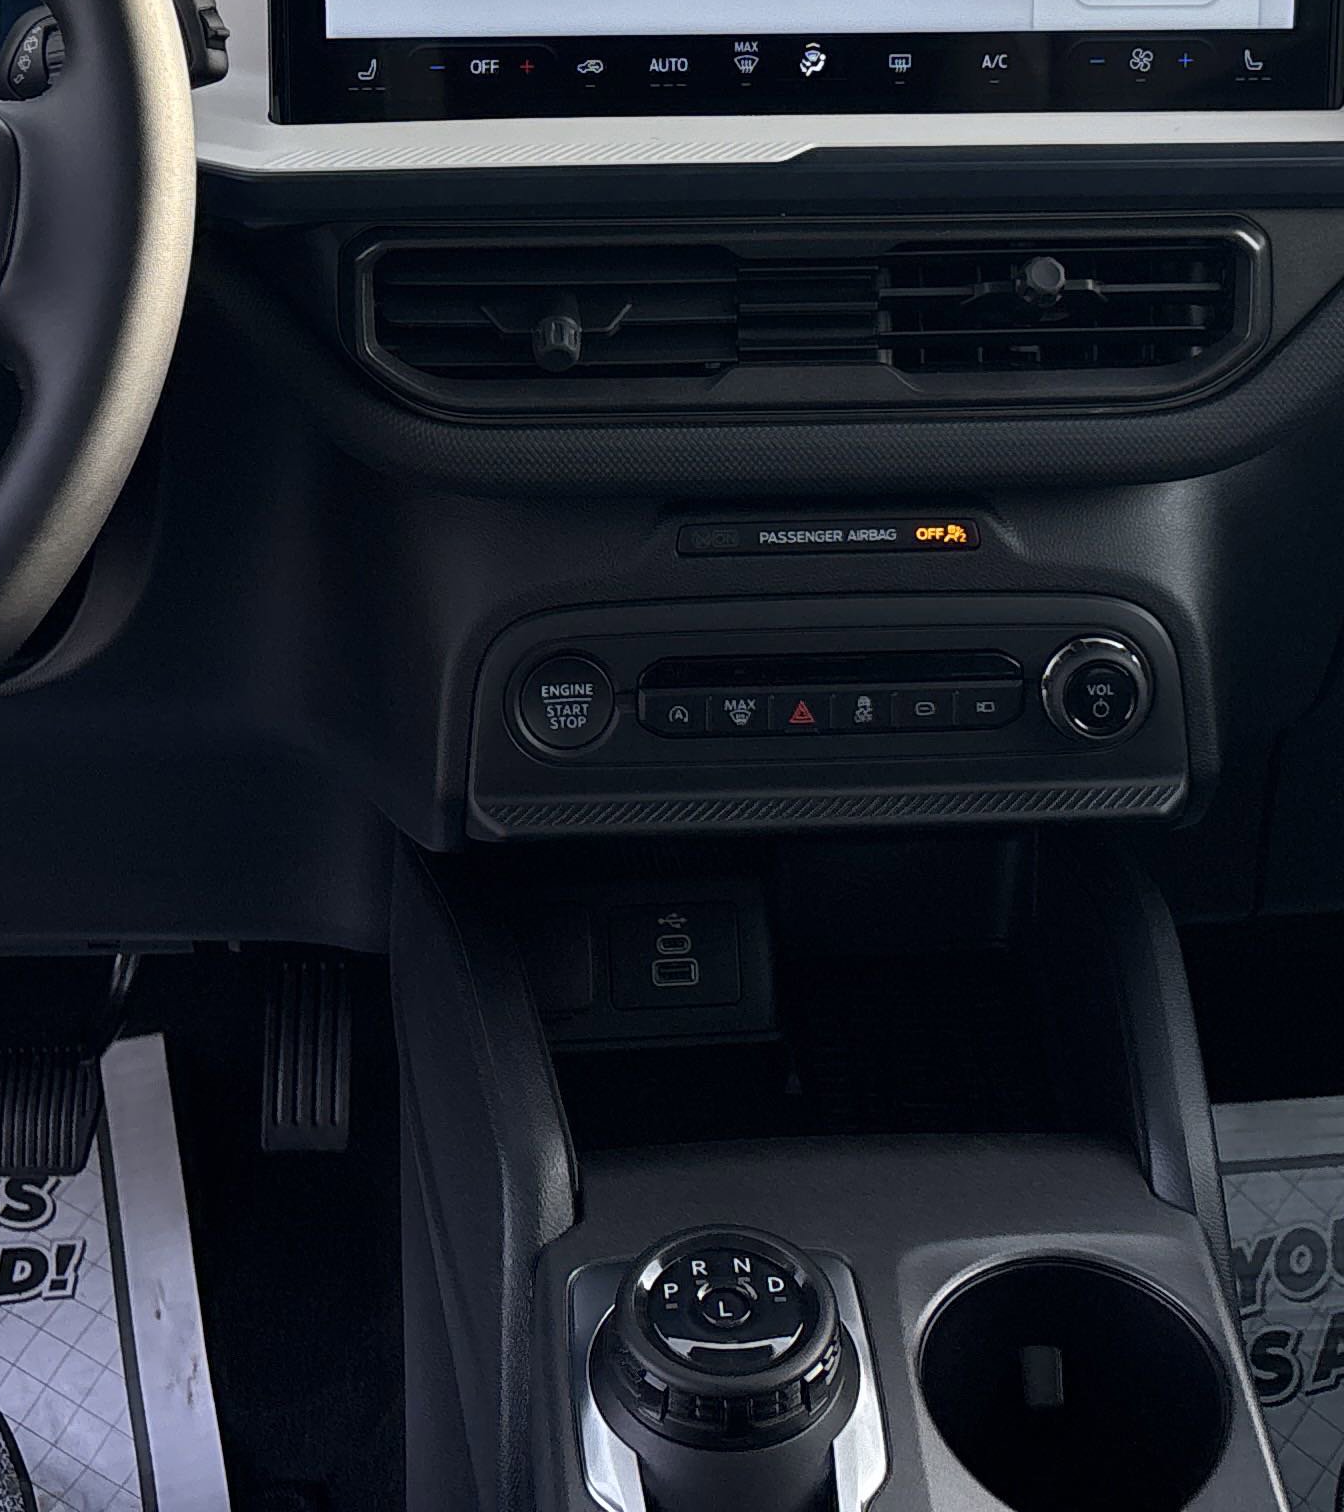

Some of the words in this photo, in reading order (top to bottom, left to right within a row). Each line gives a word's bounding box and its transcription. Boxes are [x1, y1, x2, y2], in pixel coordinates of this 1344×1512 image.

[734, 41, 759, 53] MAX
[469, 59, 500, 75] OFF
[649, 57, 689, 73] AUTO
[981, 53, 1009, 69] A/C
[759, 529, 843, 544] PASSENGER
[847, 528, 897, 543] AIRBAG
[916, 527, 945, 542] OFF
[541, 683, 594, 698] ENGINE
[1086, 684, 1115, 696] VOL
[546, 703, 589, 717] START
[723, 699, 757, 711] MAX
[549, 716, 588, 730] STOP
[691, 1260, 708, 1276] R
[733, 1257, 752, 1273] N
[663, 1283, 679, 1299] P
[767, 1276, 785, 1293] D
[718, 1300, 733, 1318] L
